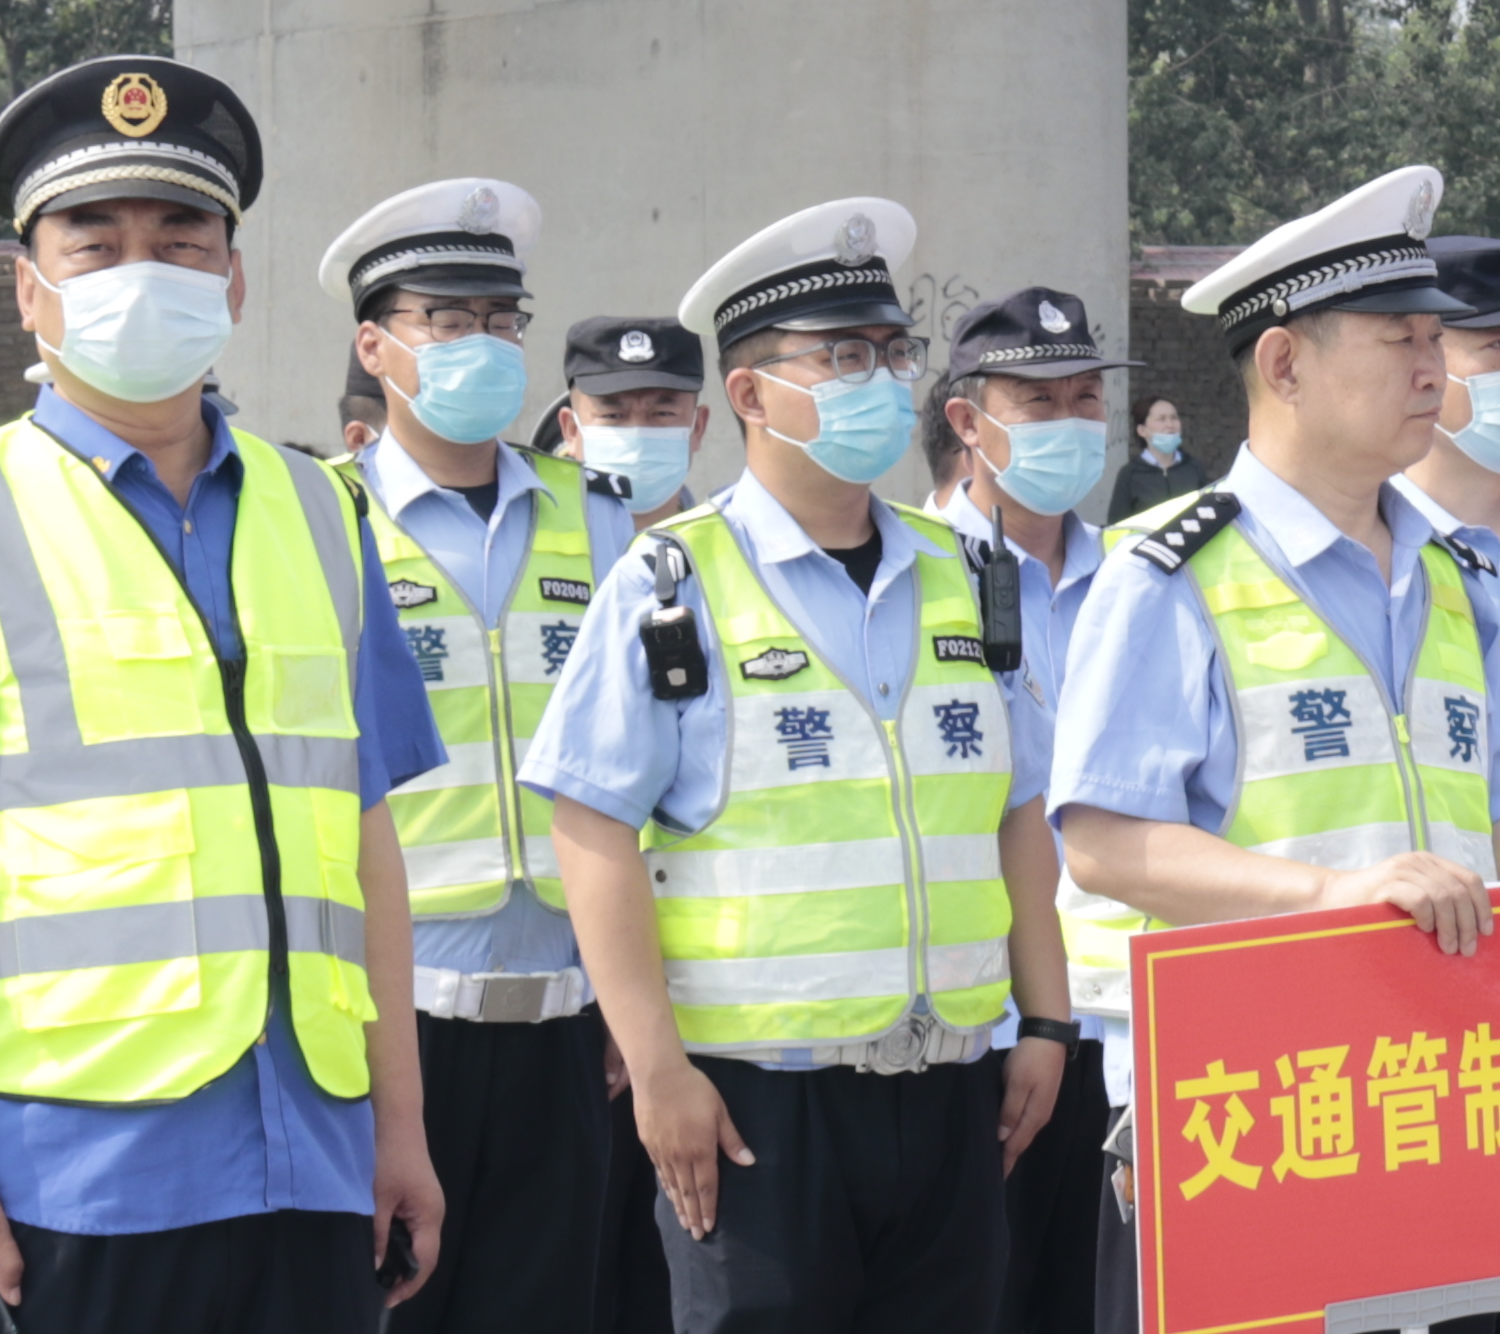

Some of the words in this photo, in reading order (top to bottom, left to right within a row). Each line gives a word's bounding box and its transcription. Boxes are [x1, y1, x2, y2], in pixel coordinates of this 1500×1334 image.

[773, 706, 834, 771] 警
[933, 698, 984, 759] 察
[1288, 688, 1353, 762] 警
[1444, 695, 1481, 763] 察
